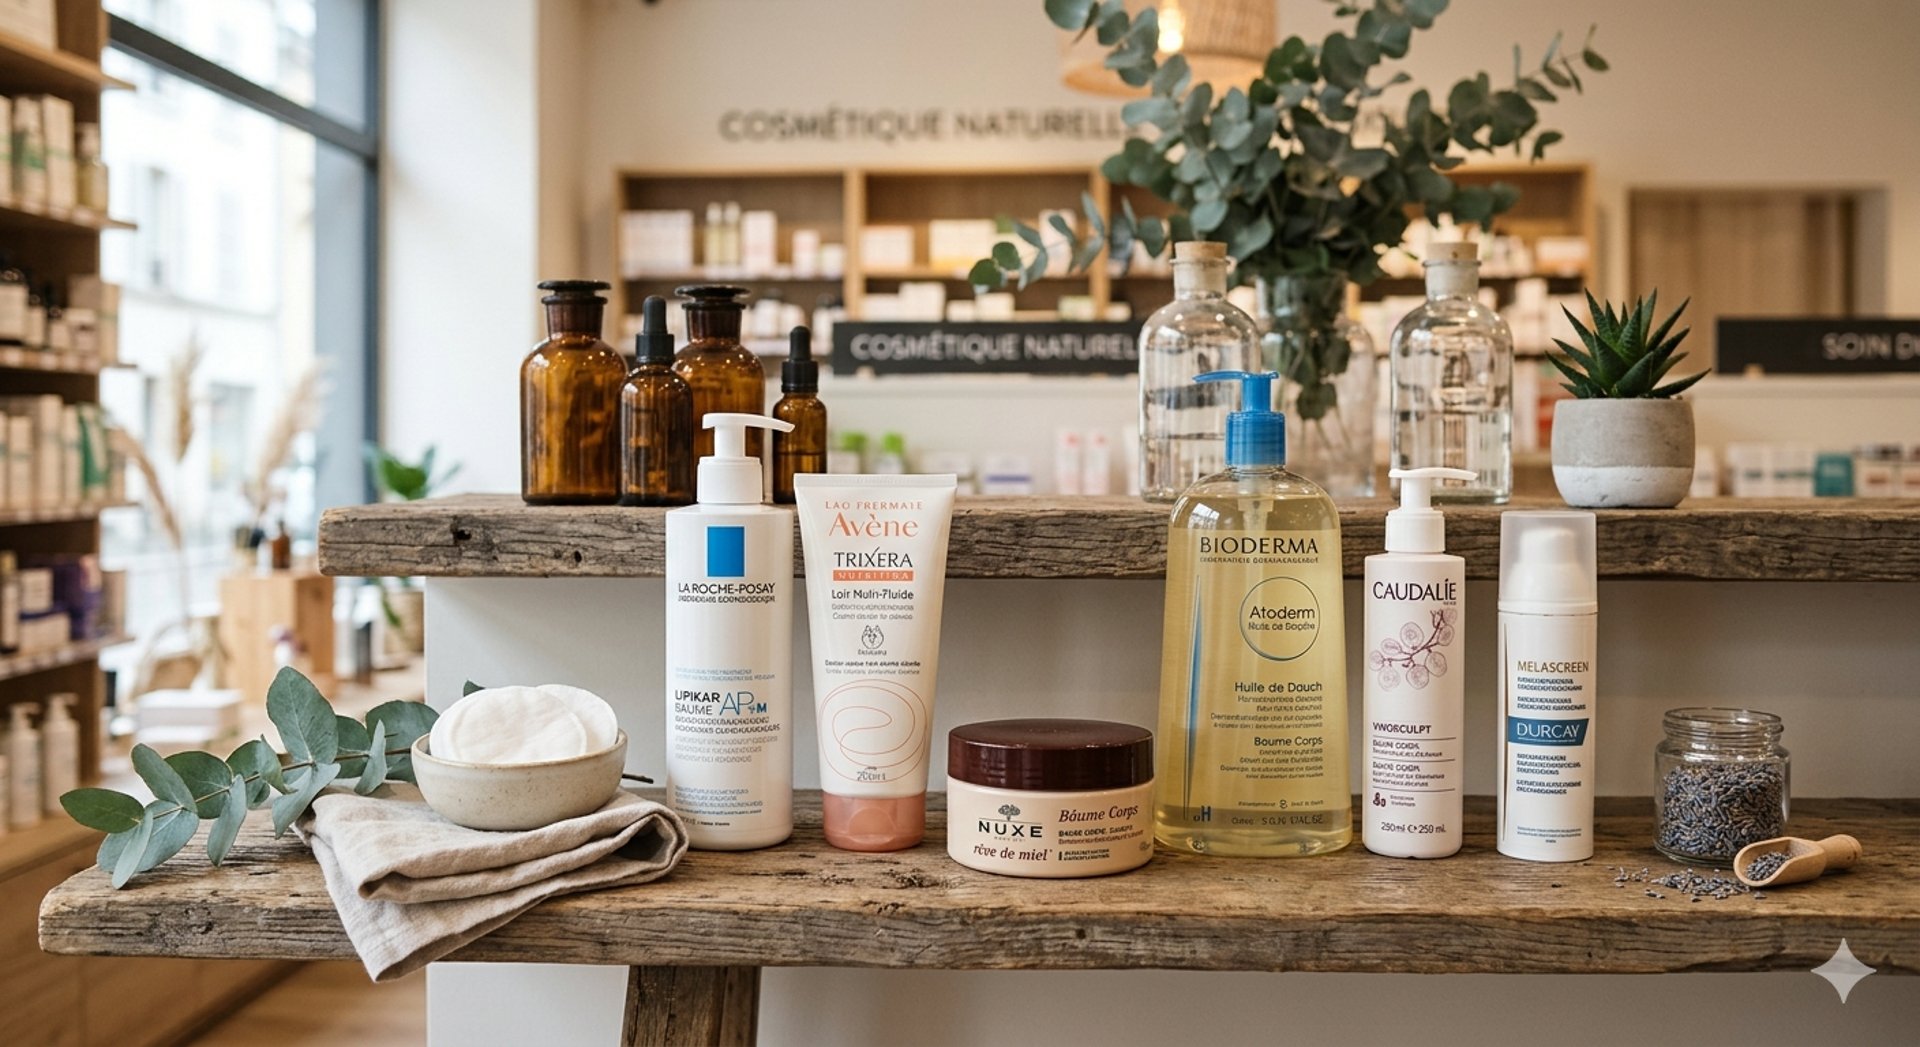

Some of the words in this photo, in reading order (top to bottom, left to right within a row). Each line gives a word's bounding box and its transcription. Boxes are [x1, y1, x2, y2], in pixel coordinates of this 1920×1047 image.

[719, 103, 940, 143] COSMÉTIQUE
[955, 109, 1141, 140] NATURELL
[850, 330, 1018, 364] COSMÉTIQUE
[1024, 333, 1138, 360] NATUREL
[1822, 332, 1892, 360] SOIN
[828, 511, 919, 537] Avène
[1200, 536, 1319, 554] BIODERMA
[833, 546, 913, 568] TRIXERA
[678, 583, 690, 594] LA
[692, 583, 776, 595] ROCHE-POSAY
[1249, 605, 1316, 619] Atoderm
[1517, 660, 1589, 673] MELASCREEN
[1268, 682, 1284, 693] de
[1516, 722, 1580, 738] DURCAY
[1294, 736, 1324, 747] Corps
[1108, 805, 1139, 820] Corps
[978, 820, 1043, 838] NUXE
[1000, 847, 1015, 860] de
